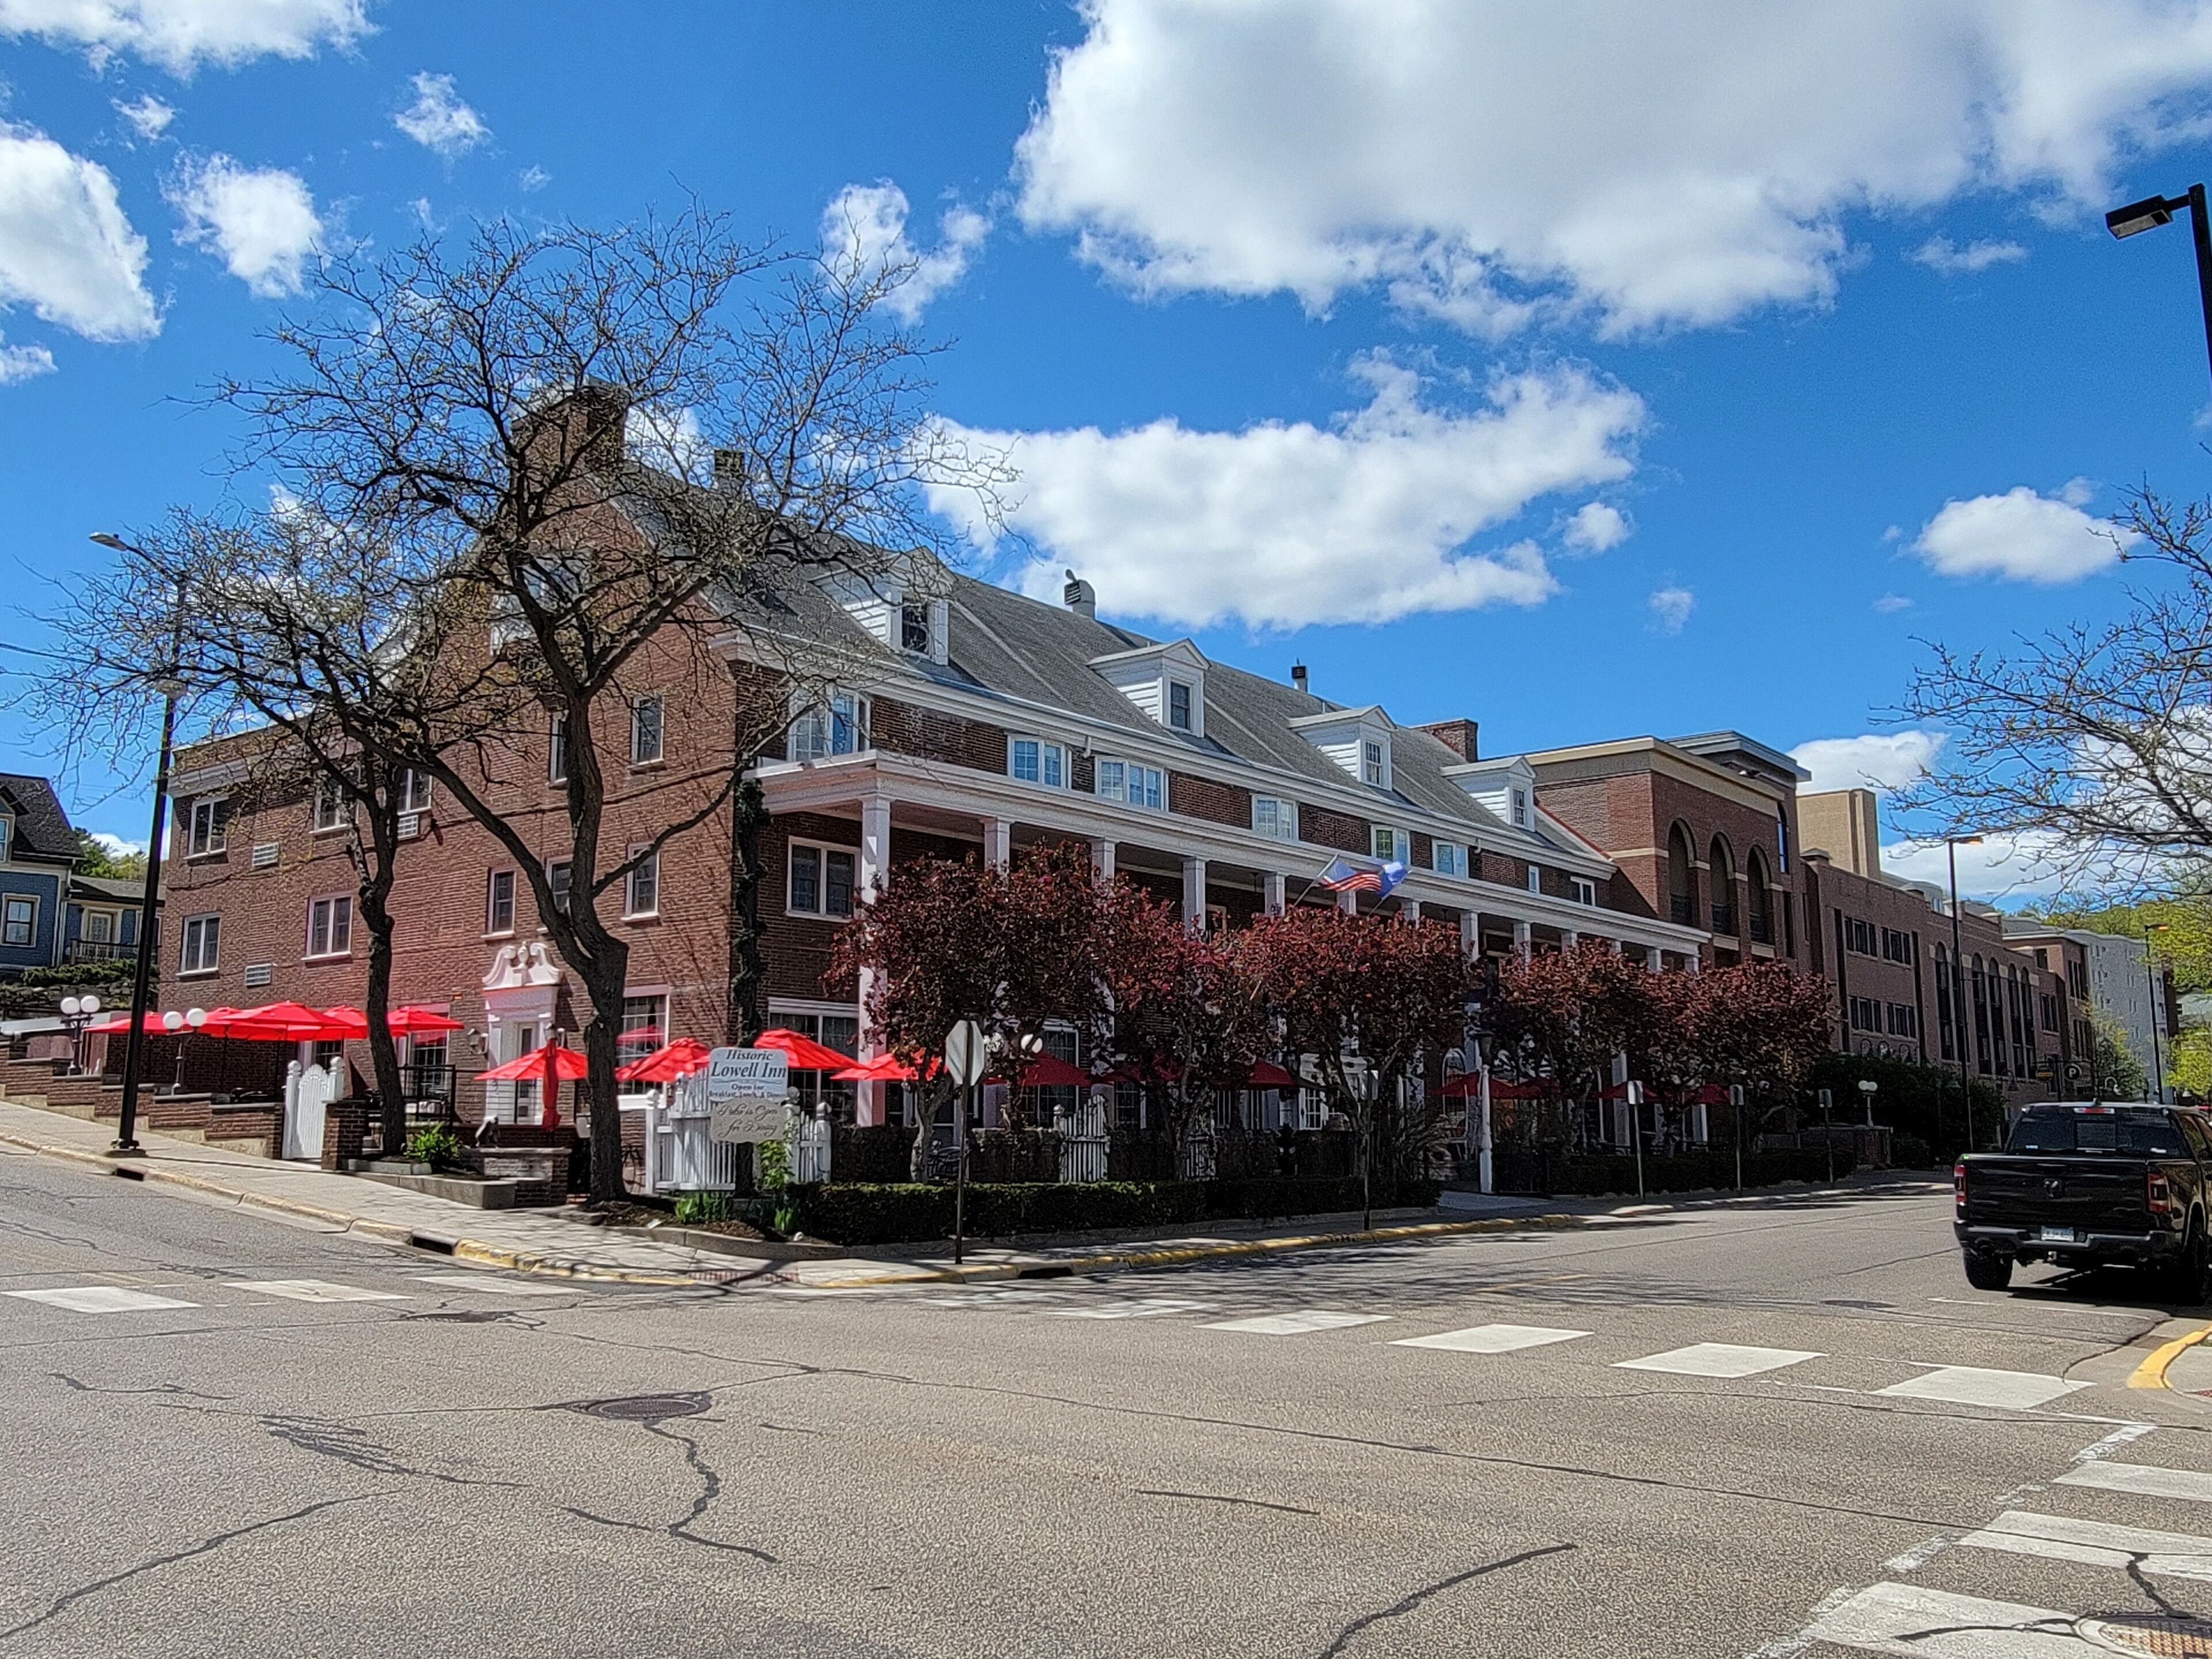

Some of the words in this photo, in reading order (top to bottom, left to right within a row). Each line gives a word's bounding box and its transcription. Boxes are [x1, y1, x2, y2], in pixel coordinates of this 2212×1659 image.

[726, 1050, 773, 1060] Historic
[711, 1061, 759, 1077] Lowell
[761, 1062, 786, 1078] Inn
[2069, 1067, 2077, 1078] P
